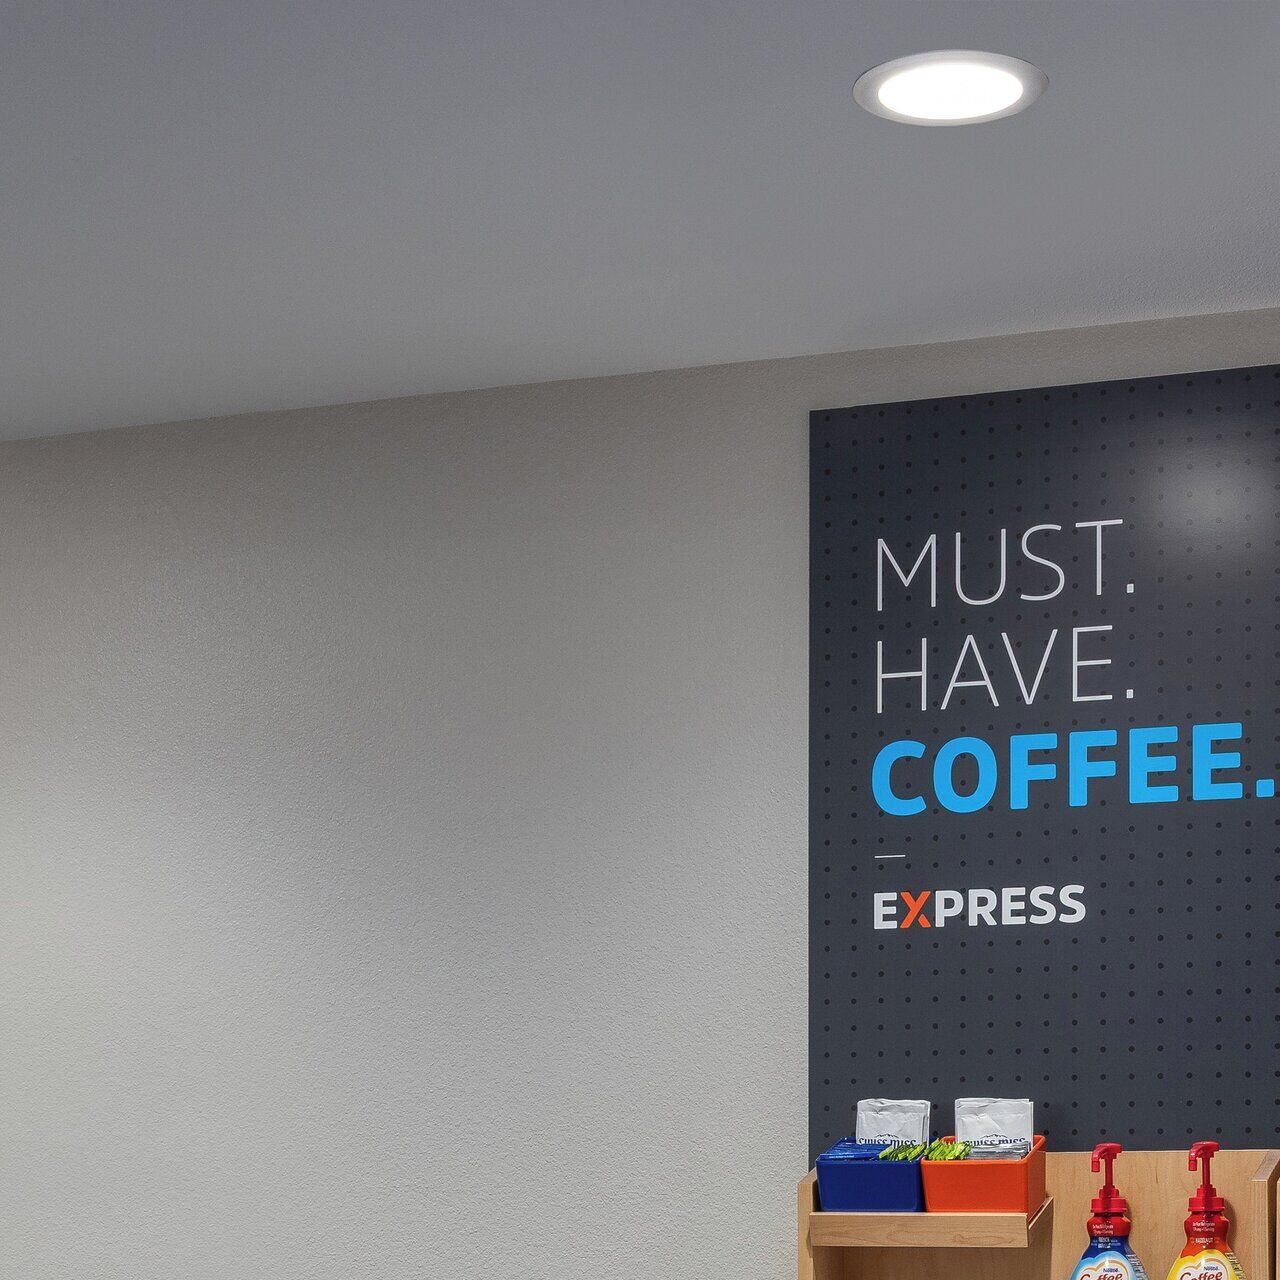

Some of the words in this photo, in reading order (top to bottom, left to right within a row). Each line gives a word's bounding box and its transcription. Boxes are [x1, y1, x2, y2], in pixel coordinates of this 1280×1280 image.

[877, 518, 1135, 611] MUST.
[877, 624, 1135, 714] HAVE.
[871, 722, 1275, 816] COFFEE.
[873, 884, 1087, 930] EXPRESS
